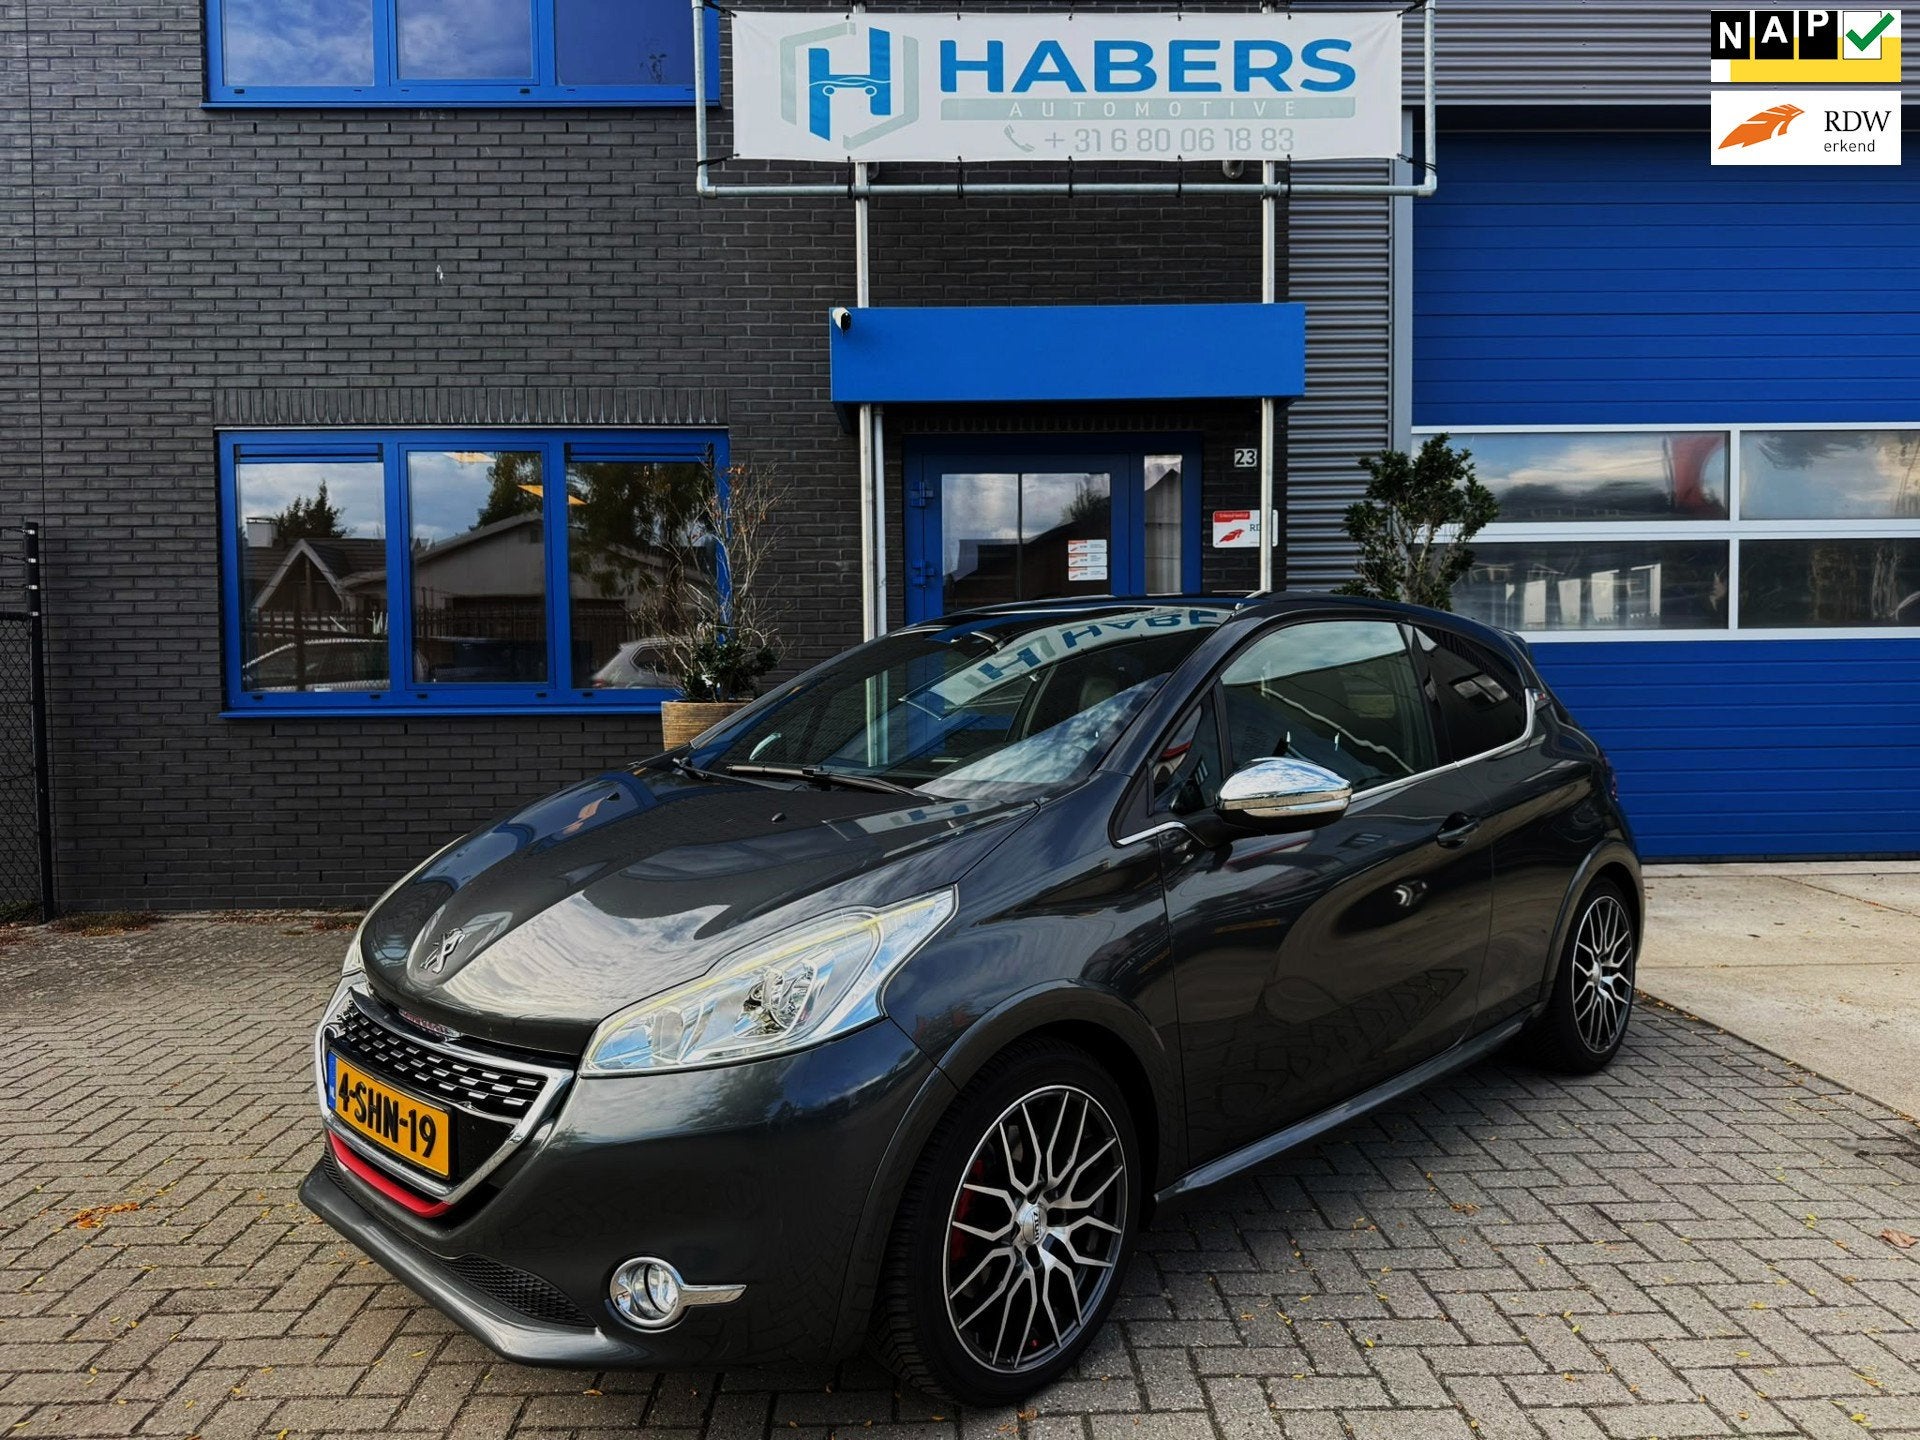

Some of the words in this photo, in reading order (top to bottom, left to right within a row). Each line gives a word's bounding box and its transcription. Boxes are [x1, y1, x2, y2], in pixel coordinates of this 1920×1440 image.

[940, 39, 1357, 94] HABERS
[1010, 102, 1297, 118] AUTOMOTIVE
[1074, 129, 1101, 152] 31
[1111, 129, 1127, 152] 6
[1136, 128, 1171, 152] 80
[1180, 128, 1215, 151] 06
[1224, 128, 1252, 151] 18
[1261, 128, 1294, 151] 83
[1235, 450, 1256, 465] 23
[339, 1072, 436, 1158] 4-SHN-19
